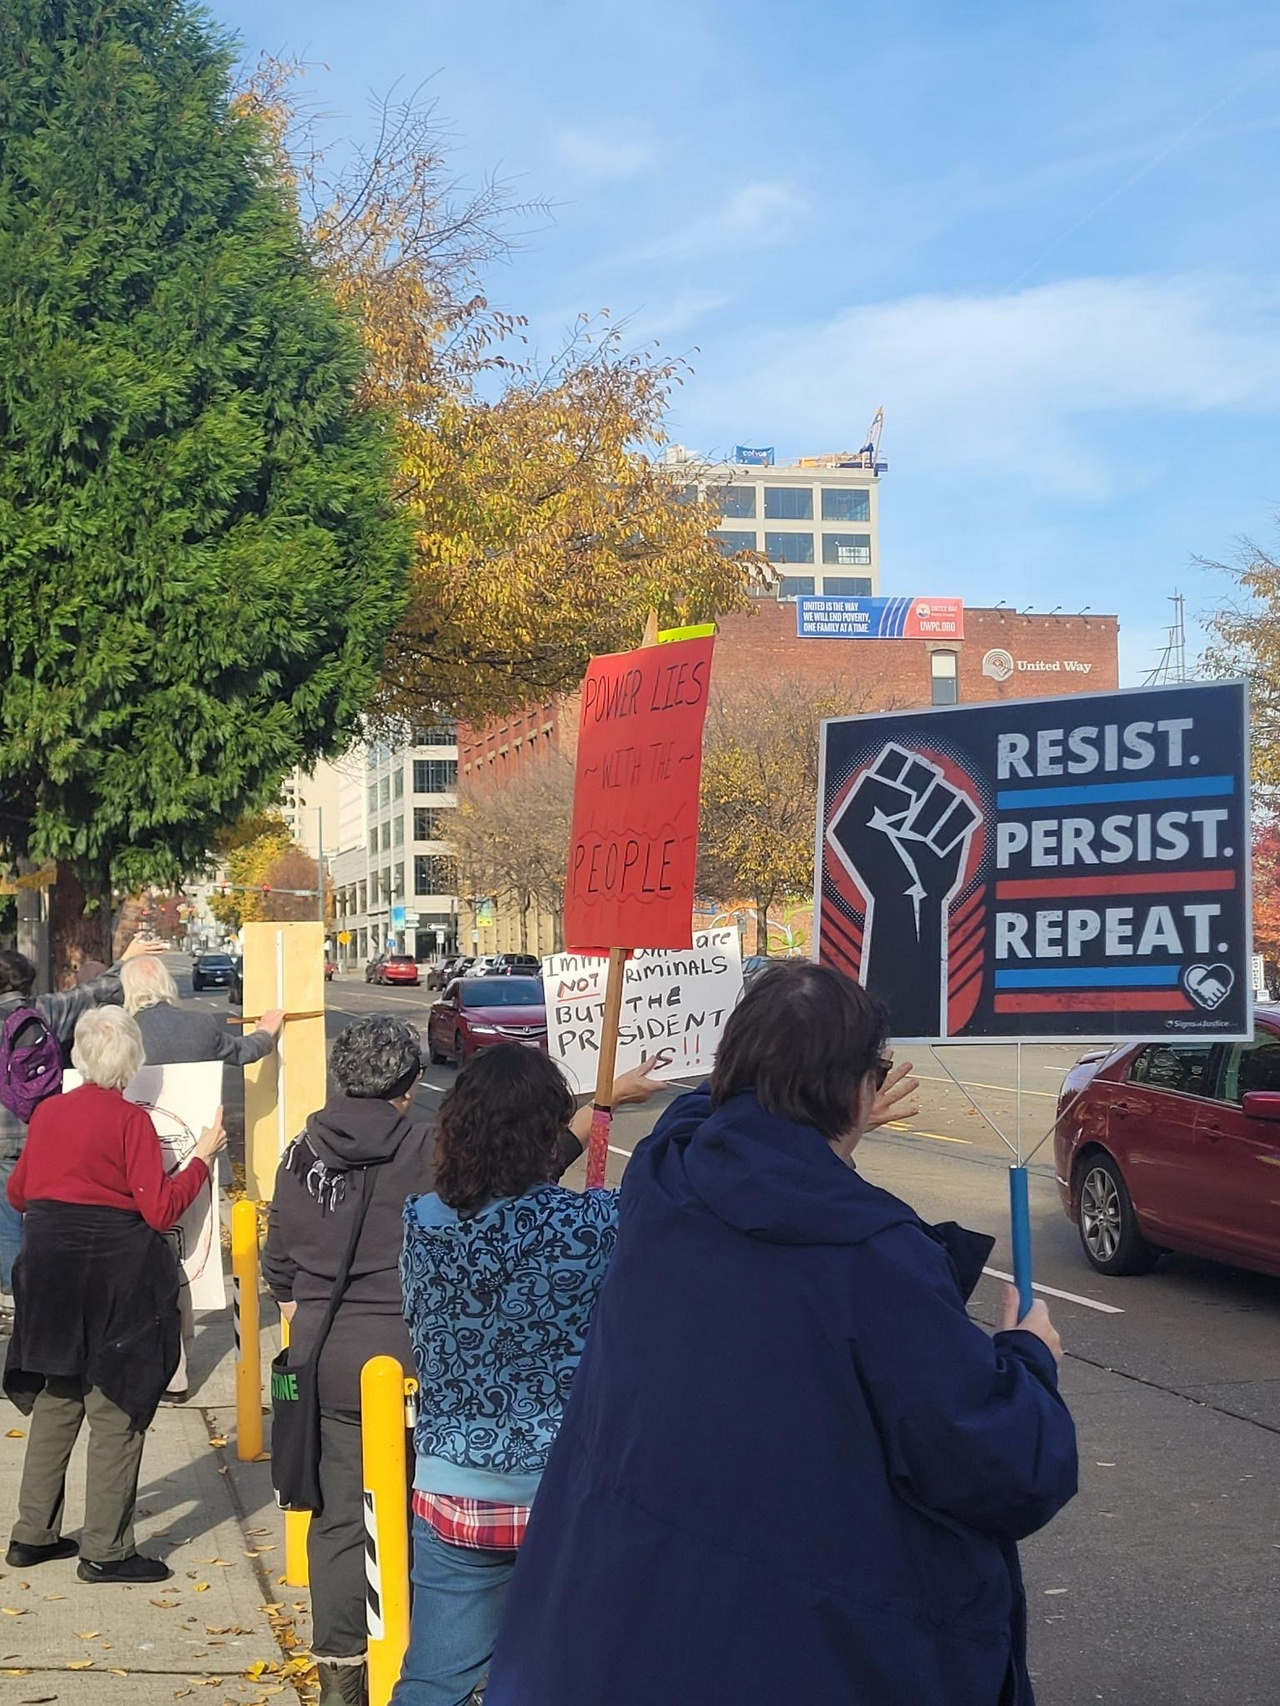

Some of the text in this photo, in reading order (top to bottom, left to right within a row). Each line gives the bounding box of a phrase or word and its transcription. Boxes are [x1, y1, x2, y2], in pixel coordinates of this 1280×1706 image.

[803, 602, 859, 611] UNITED IS THE WAY
[803, 612, 814, 621] WE
[814, 612, 829, 621] WILL
[829, 612, 842, 621] END
[803, 622, 817, 632] ONE
[817, 622, 840, 632] FAMILY
[840, 622, 848, 632] AT
[920, 621, 956, 632] UWPC.ORG
[1016, 660, 1092, 674] United Way
[583, 661, 705, 727] POWER LIES
[997, 718, 1200, 779] RESIST.
[602, 742, 676, 789] WITH THE
[996, 809, 1234, 868] PERSIST.
[573, 839, 675, 894] PEOPLE
[696, 932, 731, 949] are
[995, 904, 1228, 959] REPEAT.
[556, 973, 599, 998] NOT
[555, 986, 681, 1025] BUT THE
